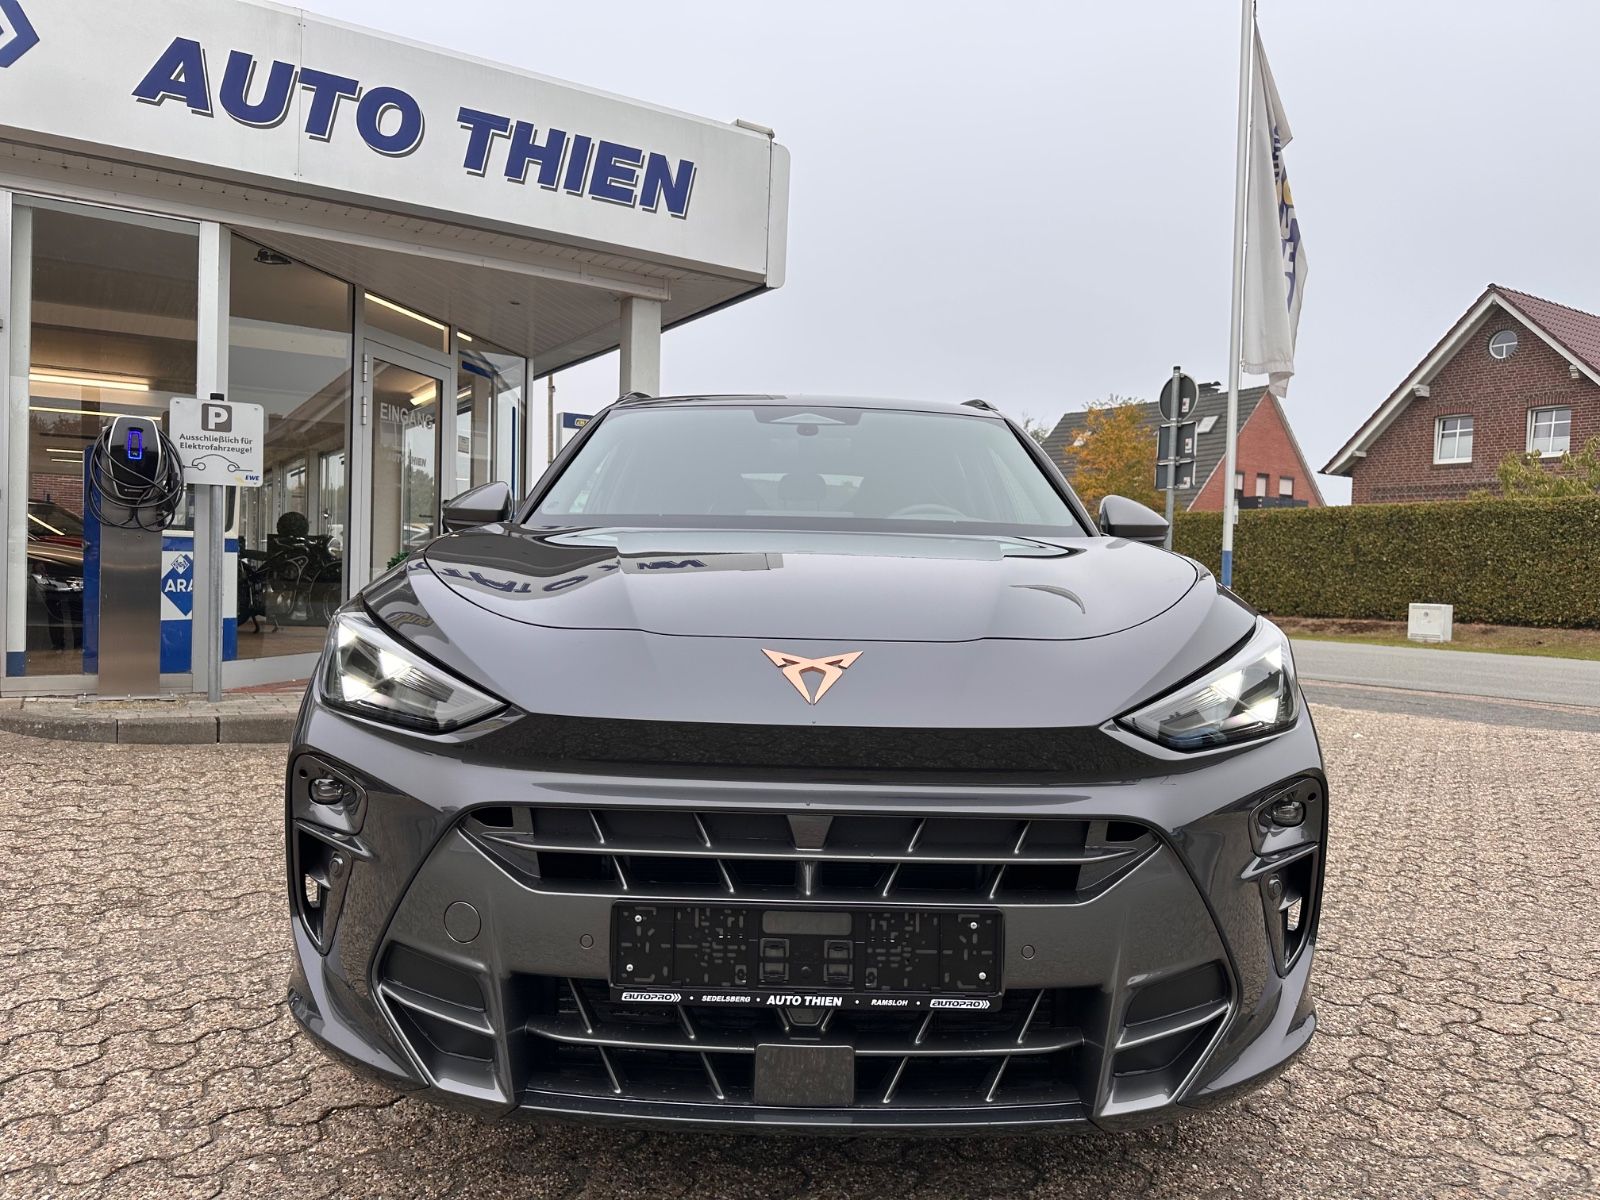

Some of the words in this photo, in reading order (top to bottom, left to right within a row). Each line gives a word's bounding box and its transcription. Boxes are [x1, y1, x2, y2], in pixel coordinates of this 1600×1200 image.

[131, 37, 425, 157] AUTO
[457, 106, 697, 220] THIEN
[208, 406, 229, 430] P
[380, 402, 433, 429] EINGANG
[179, 433, 239, 444] Ausschließlich
[179, 442, 253, 455] Elektrofahrzeuge!
[701, 995, 751, 1003] SEDELSBERG
[766, 995, 802, 1006] AUTO
[804, 996, 843, 1007] THIEN
[871, 999, 909, 1007] RAMSLOH
